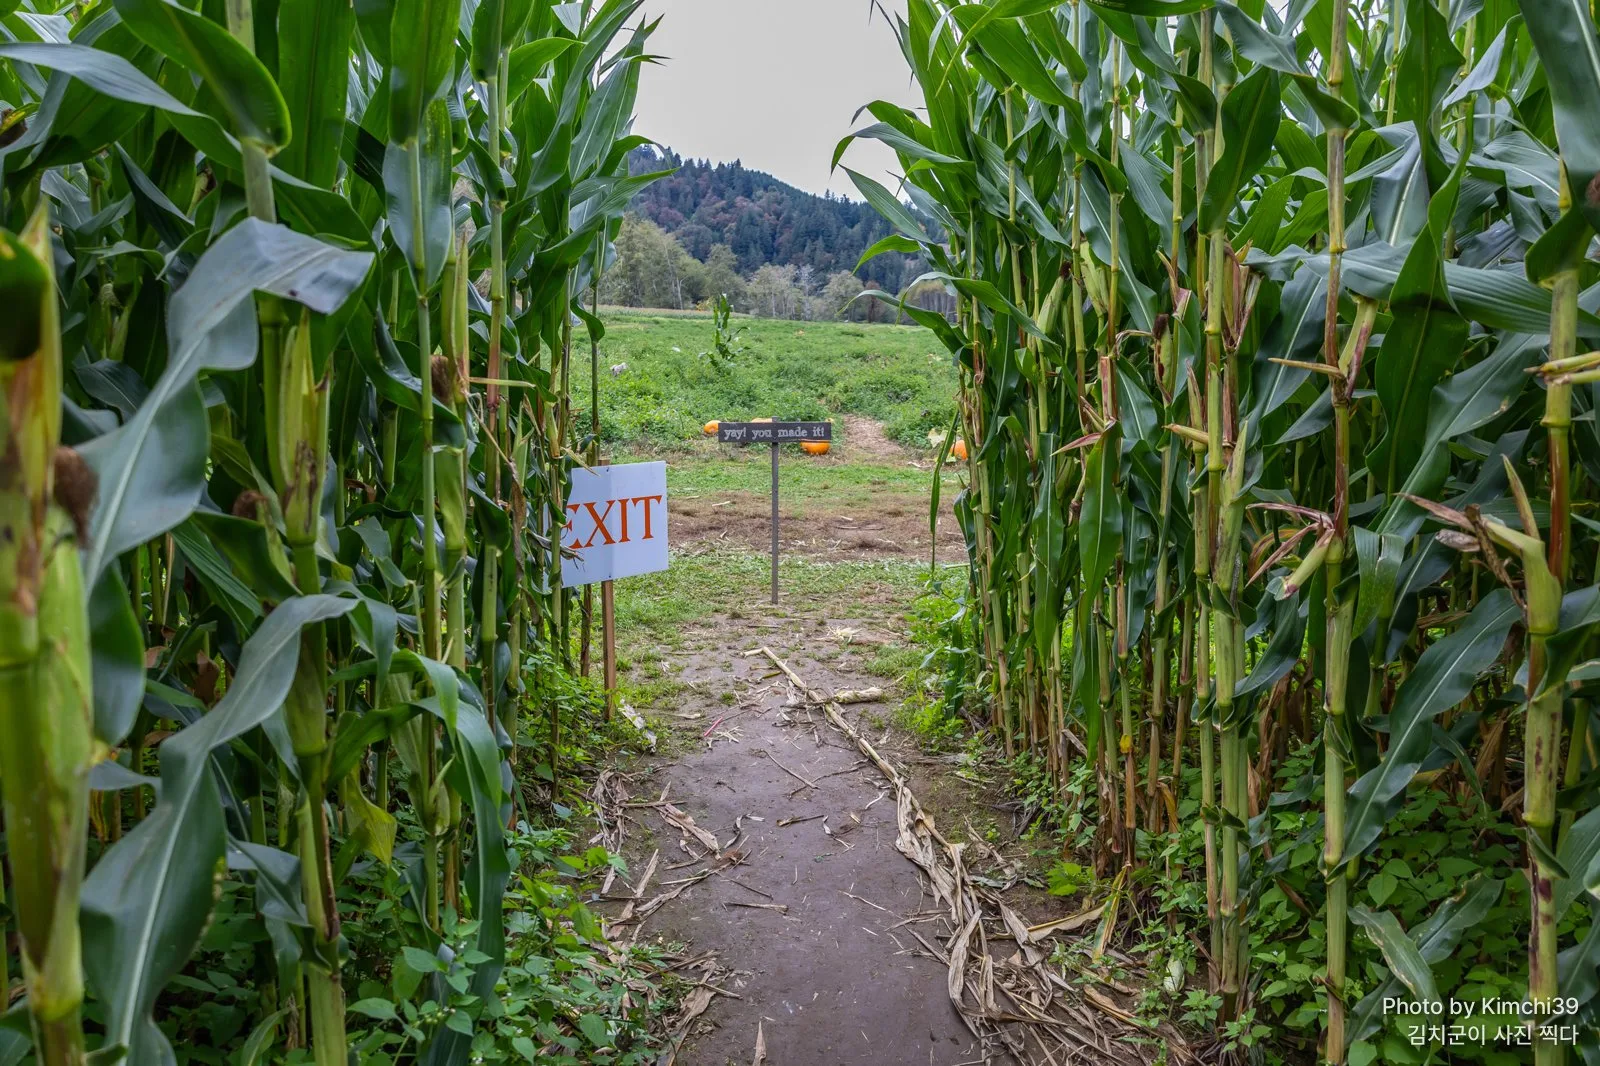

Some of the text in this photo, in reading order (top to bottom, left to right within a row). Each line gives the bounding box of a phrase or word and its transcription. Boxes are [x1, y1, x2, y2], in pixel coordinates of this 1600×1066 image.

[724, 427, 825, 440] yay! you made it!
